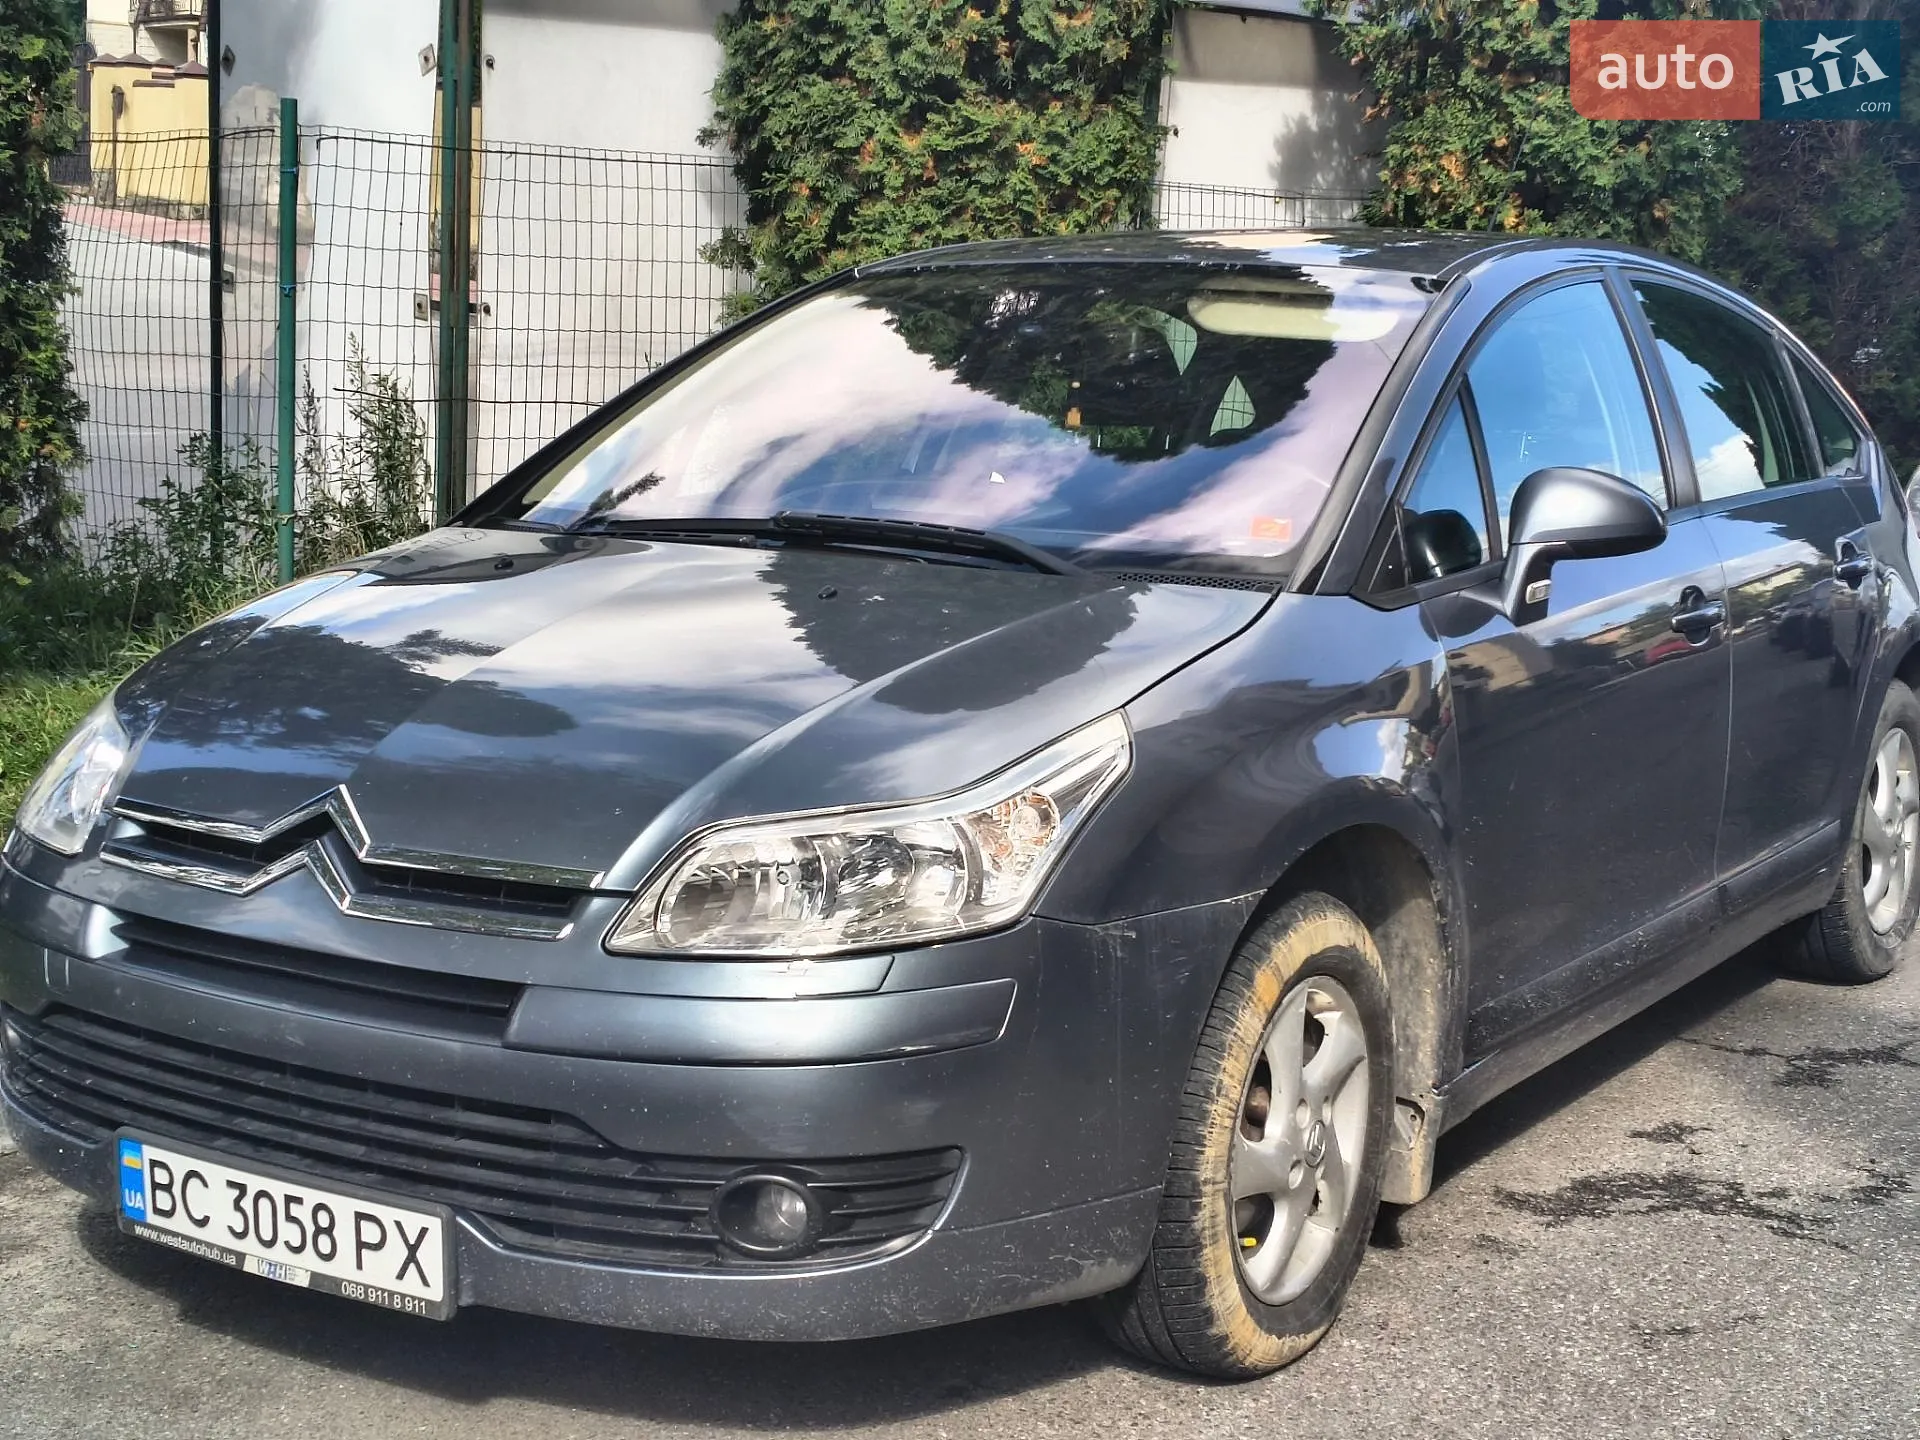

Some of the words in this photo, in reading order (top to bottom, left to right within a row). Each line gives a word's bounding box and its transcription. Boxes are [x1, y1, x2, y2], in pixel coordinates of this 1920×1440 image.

[125, 1189, 145, 1210] UA
[149, 1158, 210, 1228] BC
[226, 1179, 337, 1262] 3058
[354, 1210, 430, 1288] PX
[134, 1225, 237, 1266] www.westautohub.ua
[341, 1282, 364, 1300] 068
[368, 1288, 390, 1306] 911
[393, 1295, 402, 1309] 8
[405, 1297, 427, 1315] 911
